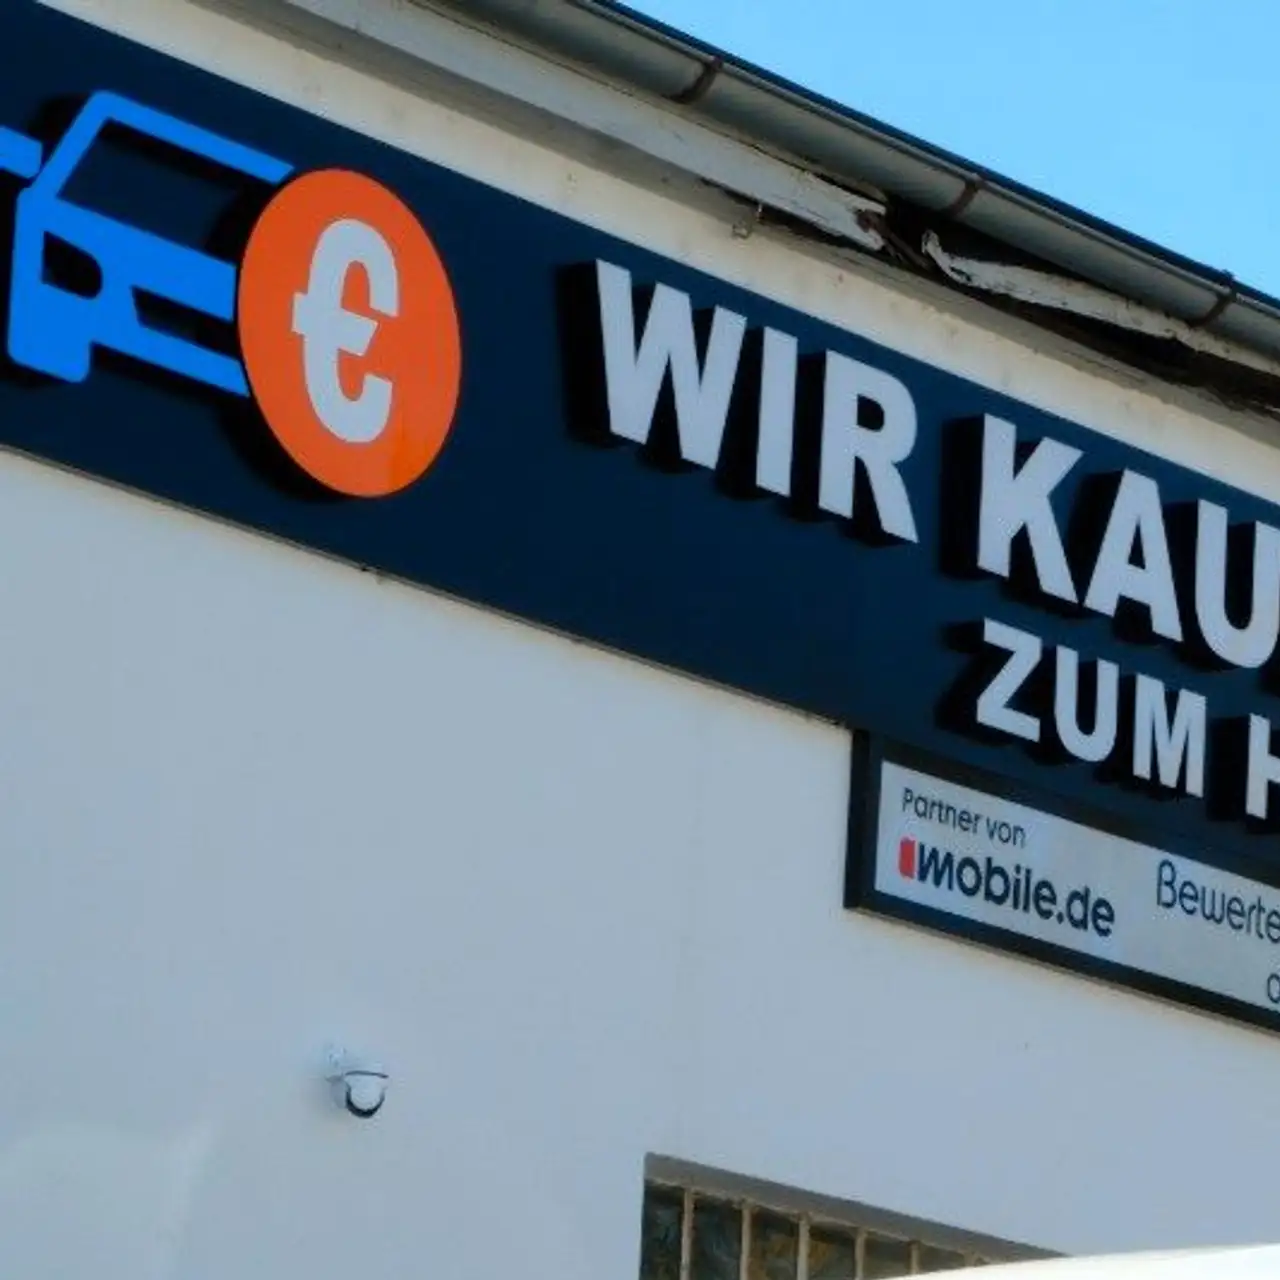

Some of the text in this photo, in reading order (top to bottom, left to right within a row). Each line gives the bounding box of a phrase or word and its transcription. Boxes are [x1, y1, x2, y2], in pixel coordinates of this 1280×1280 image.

[596, 259, 918, 543] WIR
[977, 618, 1206, 797] ZUM
[902, 787, 1026, 848] Partner von
[917, 841, 1115, 937] mobile.de
